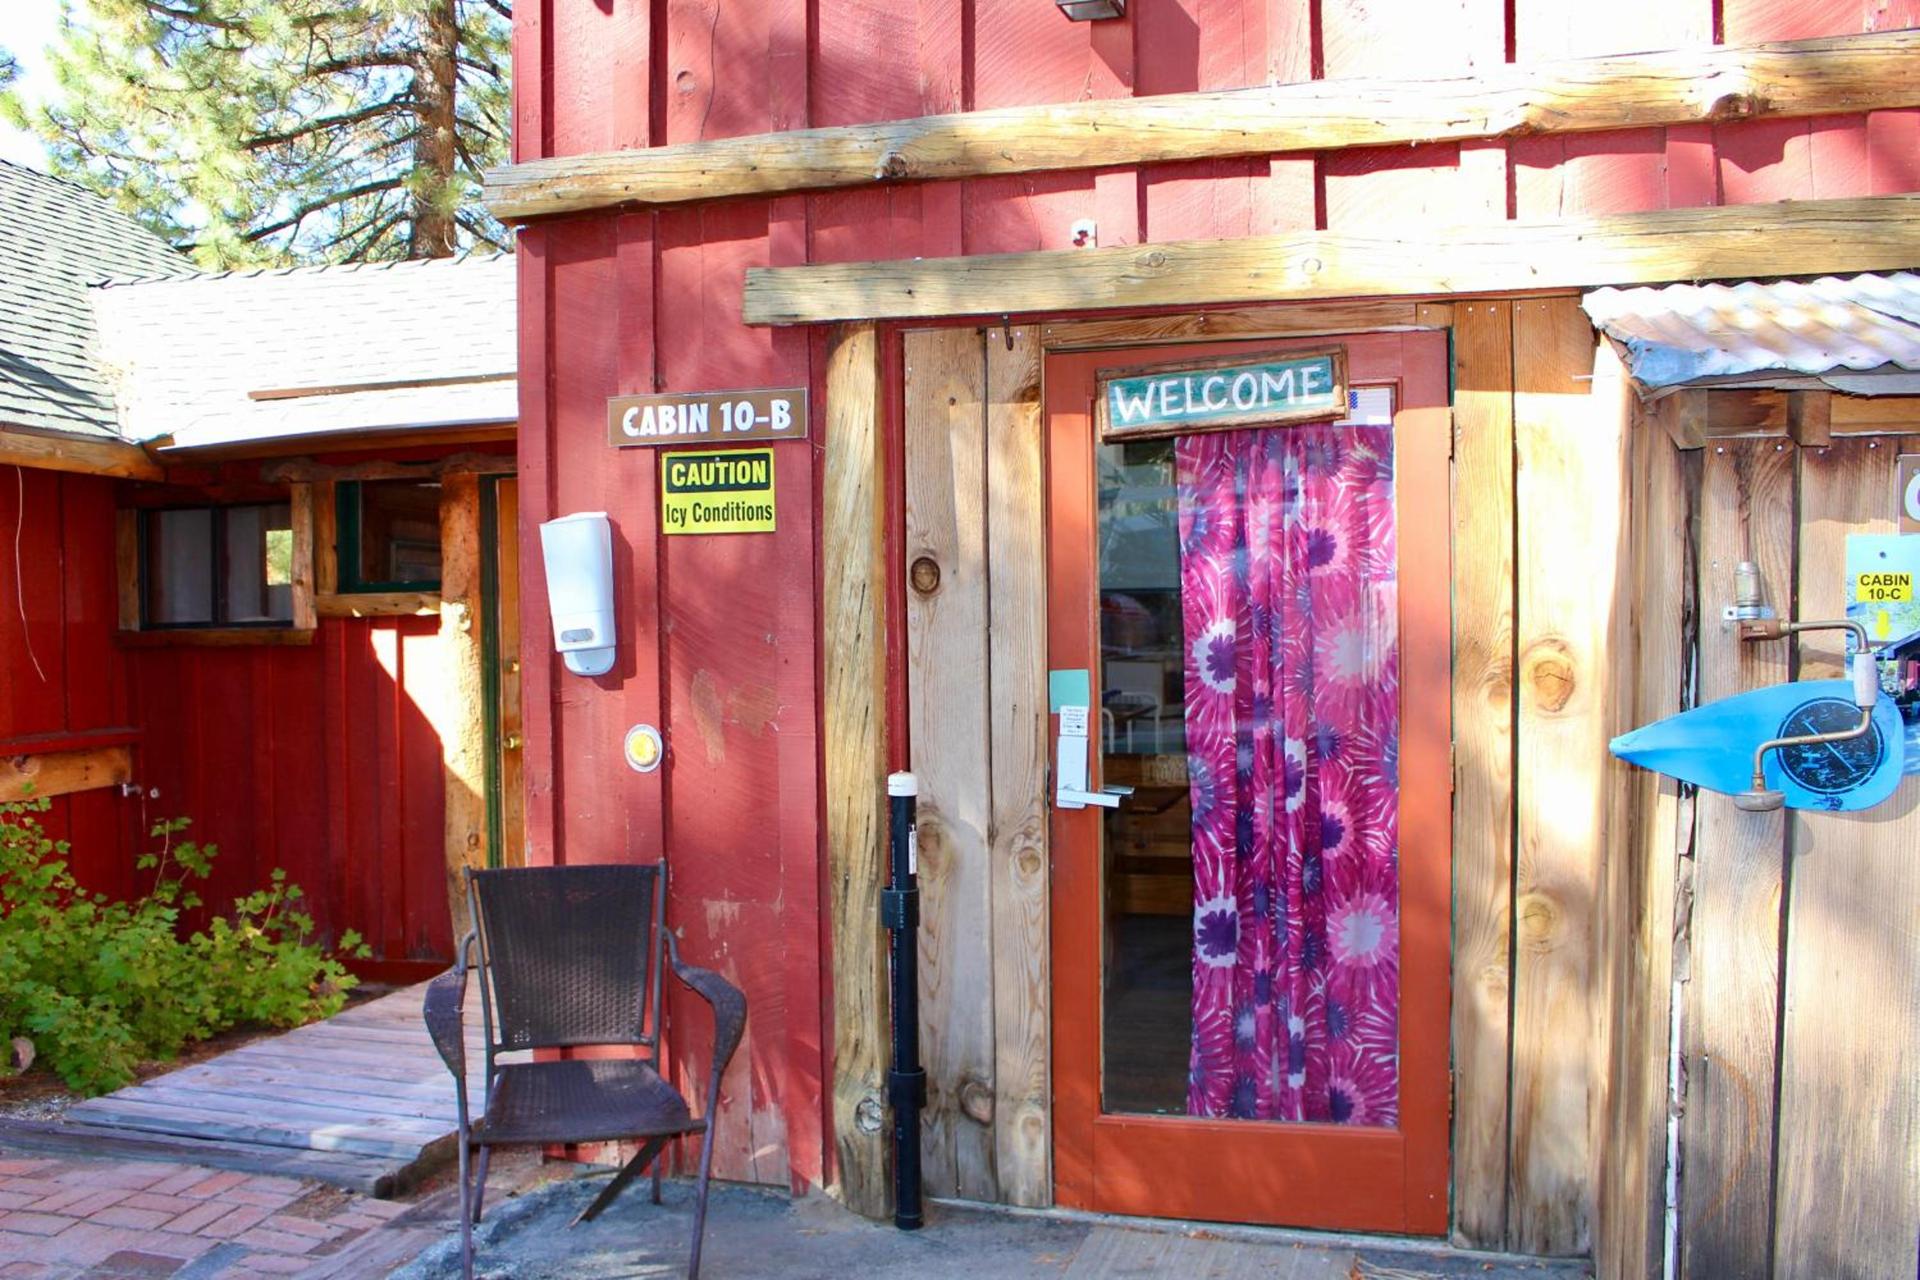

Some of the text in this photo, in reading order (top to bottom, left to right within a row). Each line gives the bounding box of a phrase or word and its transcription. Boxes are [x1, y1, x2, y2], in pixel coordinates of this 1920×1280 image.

[1114, 366, 1324, 422] WELCOME
[622, 399, 792, 437] CABIN 10-B
[671, 460, 767, 487] CAUTION
[666, 501, 773, 528] Icy Conditions
[1860, 574, 1910, 587] CABIN
[1868, 588, 1902, 600] 10-C
